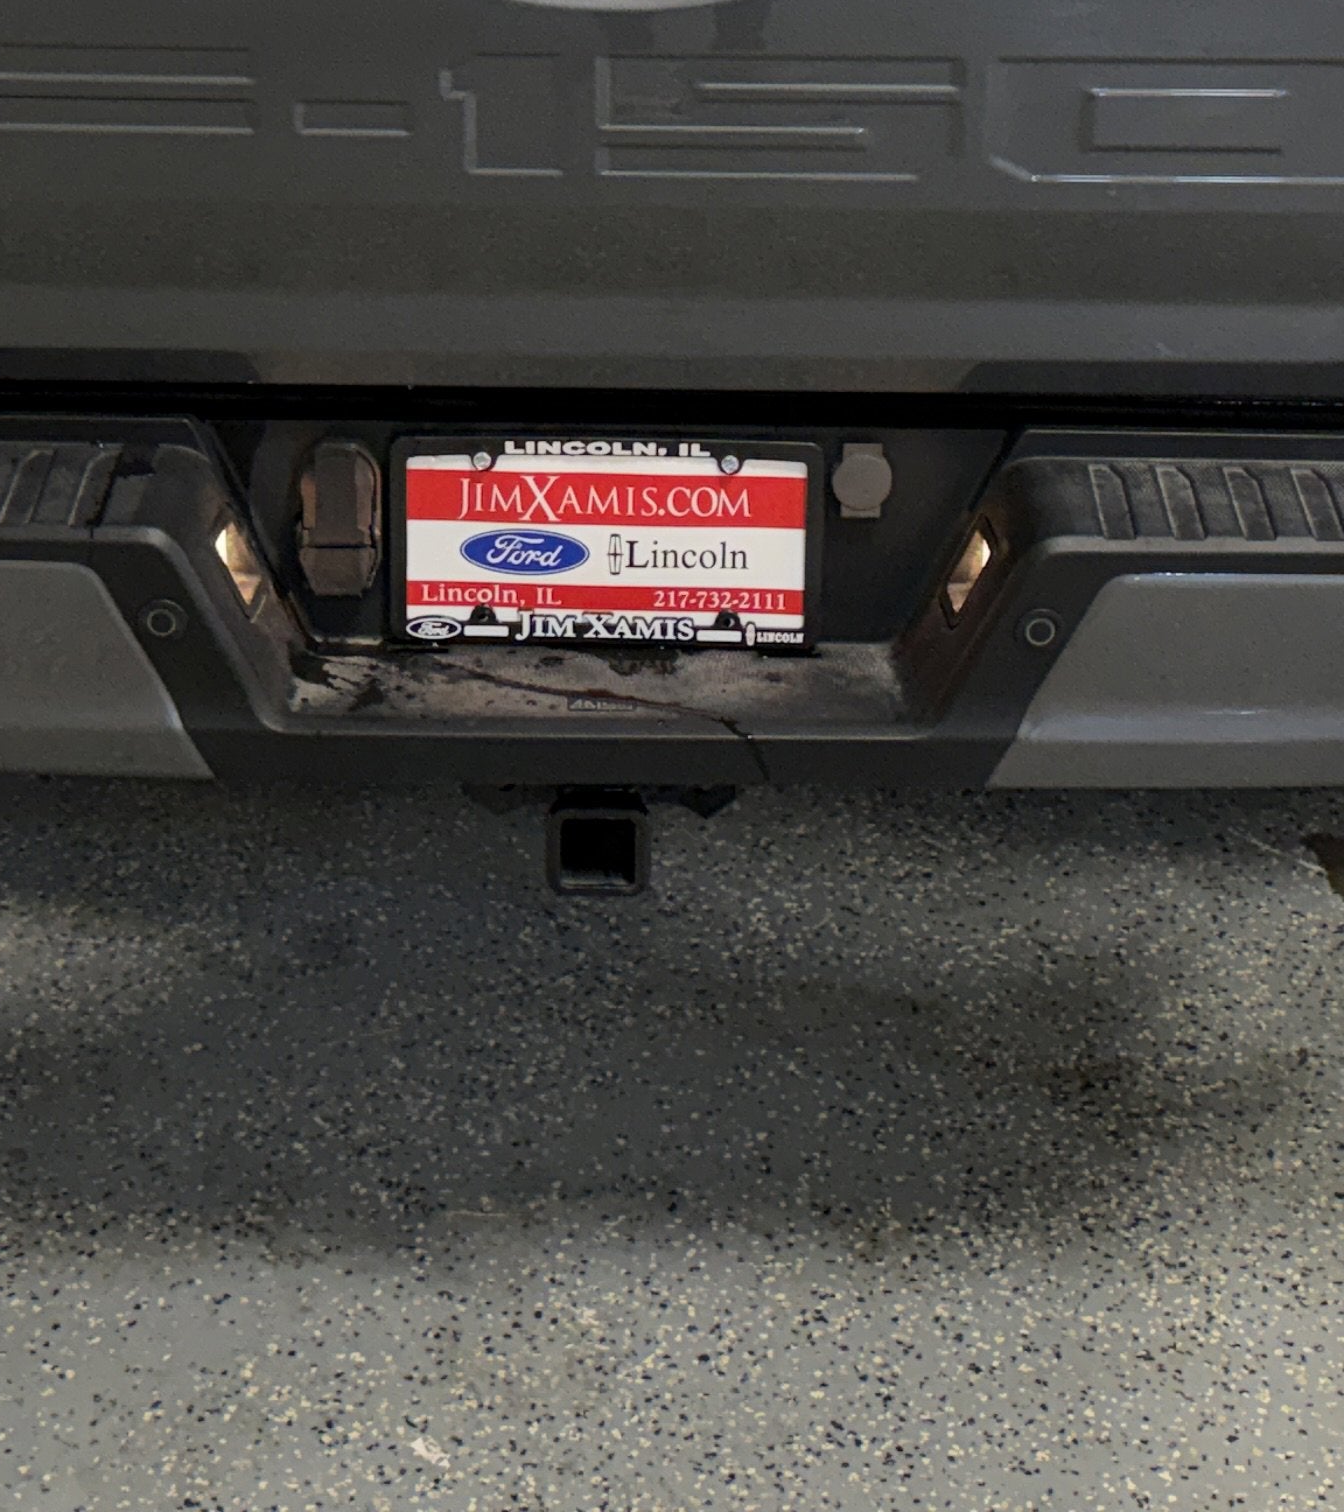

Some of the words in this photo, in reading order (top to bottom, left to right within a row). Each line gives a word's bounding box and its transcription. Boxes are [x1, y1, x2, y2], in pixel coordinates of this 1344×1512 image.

[504, 441, 667, 457] LINCOLN,
[679, 444, 711, 457] IL
[458, 475, 752, 521] JIMXAMIS.COM
[486, 535, 563, 568] Ford
[625, 541, 749, 570] Lincoln
[422, 585, 526, 606] Lincoln,
[536, 588, 562, 605] IL
[653, 590, 787, 610] 217-732-2111
[515, 610, 578, 641] JIM
[582, 612, 695, 641] XAMIS
[756, 631, 804, 644] LINCOLN
